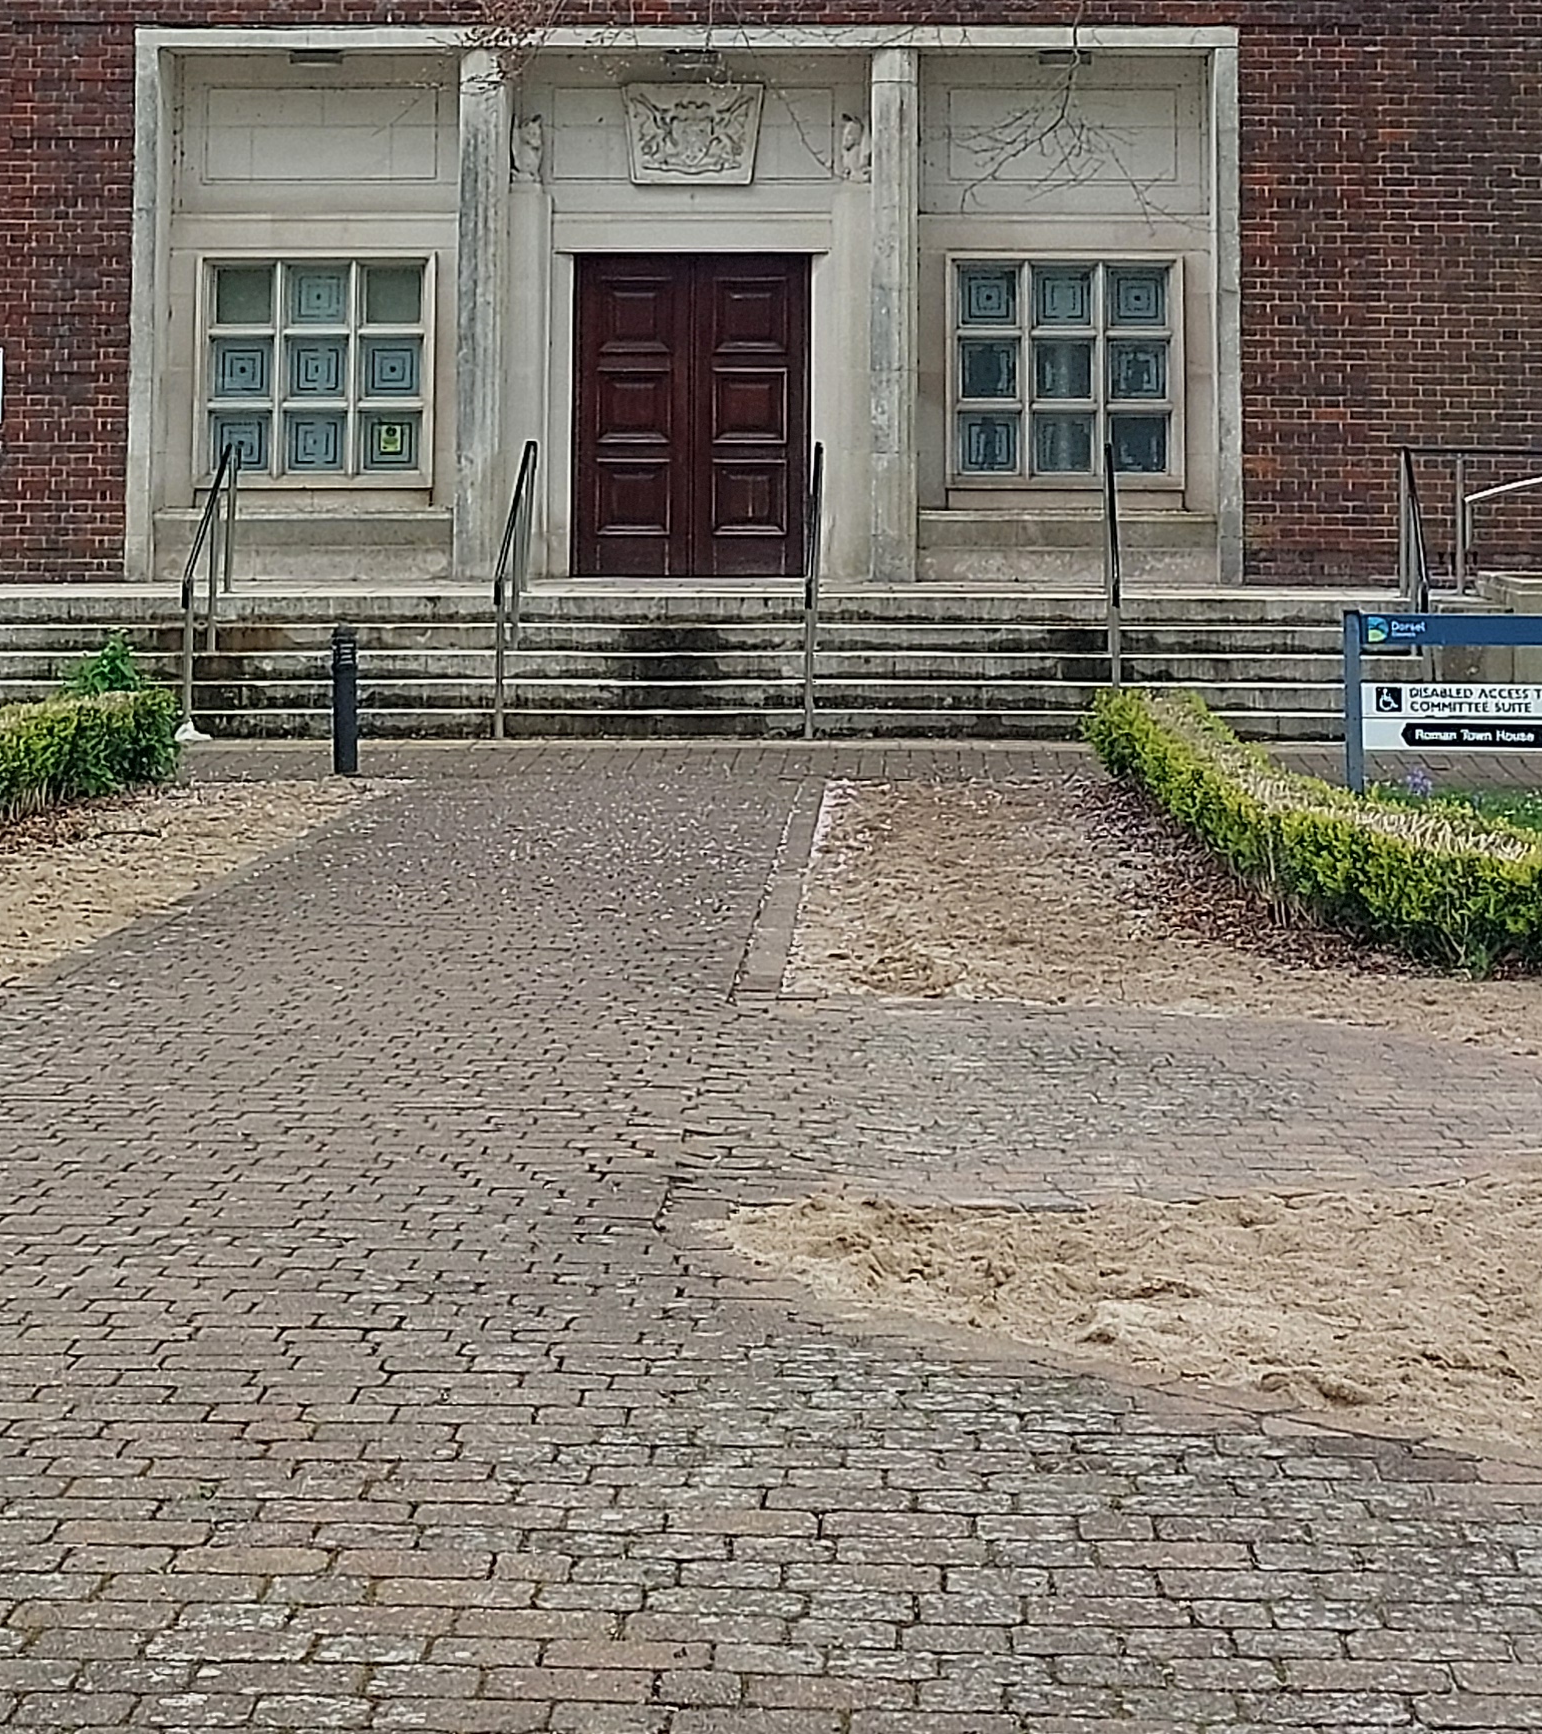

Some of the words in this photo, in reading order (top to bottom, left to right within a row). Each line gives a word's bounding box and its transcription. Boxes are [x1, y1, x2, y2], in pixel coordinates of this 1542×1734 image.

[1391, 621, 1426, 632] Dorset
[1409, 687, 1473, 699] DISABLED
[1478, 688, 1529, 699] ACCESS
[1410, 701, 1490, 713] COMMITTEE
[1495, 702, 1532, 713] SUITE
[1415, 729, 1457, 740] Roman
[1460, 729, 1493, 741] Town
[1495, 729, 1536, 742] House
